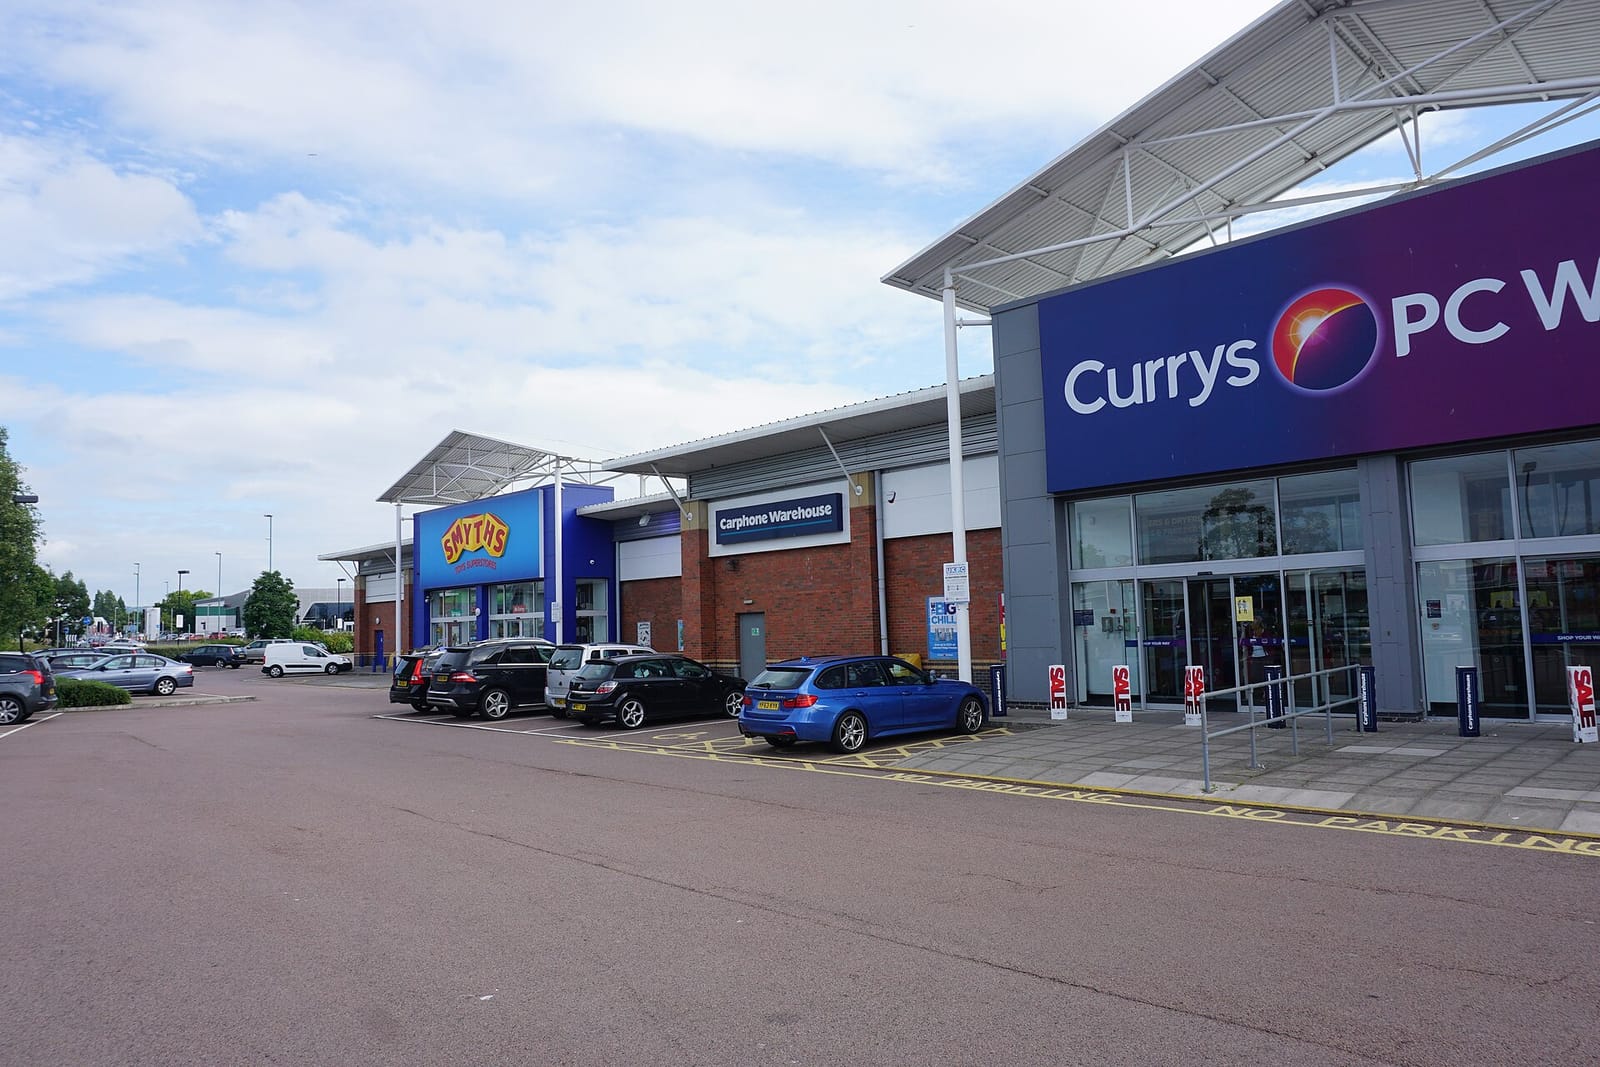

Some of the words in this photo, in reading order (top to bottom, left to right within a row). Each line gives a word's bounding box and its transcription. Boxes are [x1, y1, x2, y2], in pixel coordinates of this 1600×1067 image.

[1064, 339, 1260, 414] Currys
[1392, 278, 1511, 357] PC
[720, 513, 771, 530] Carphone
[769, 504, 832, 522] Warehouse
[444, 519, 506, 561] SMYTHS
[931, 615, 957, 624] CHILL
[936, 602, 957, 615] BIG
[1050, 667, 1066, 709] SALE
[1114, 667, 1131, 712] SALE
[1574, 670, 1597, 728] SALE
[882, 773, 932, 781] NO
[940, 779, 1122, 802] PARKING
[1207, 805, 1286, 819] NO
